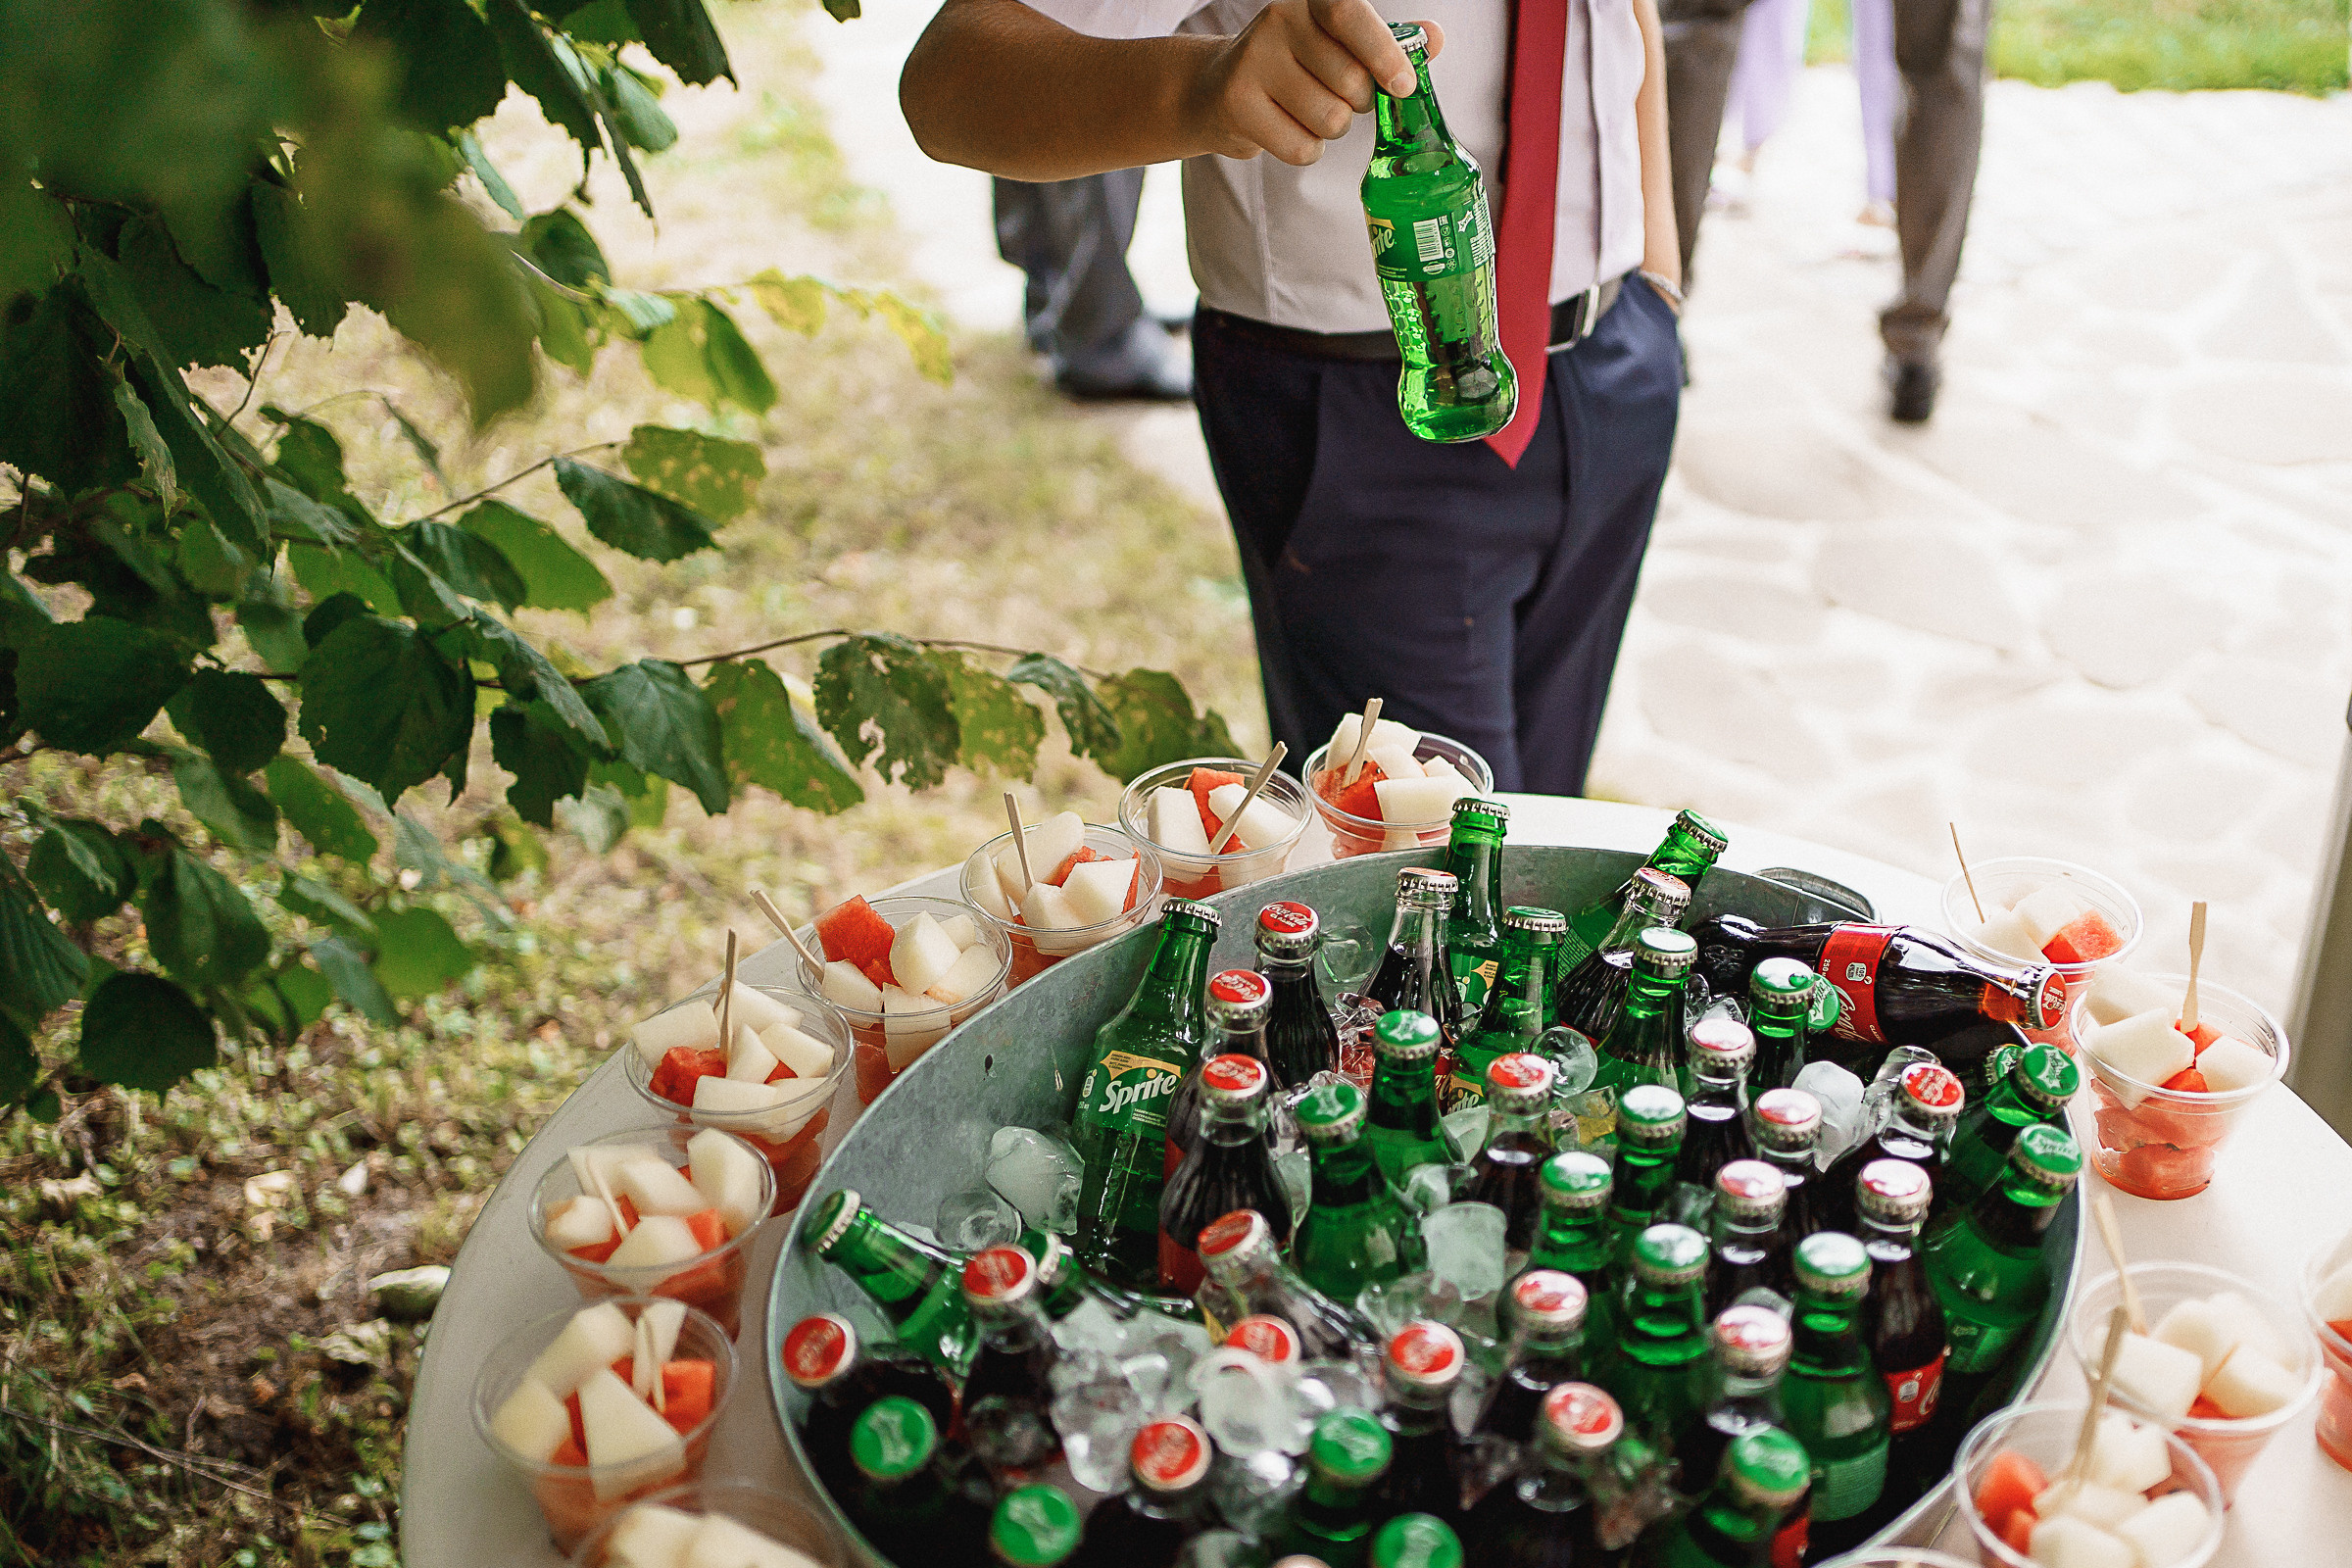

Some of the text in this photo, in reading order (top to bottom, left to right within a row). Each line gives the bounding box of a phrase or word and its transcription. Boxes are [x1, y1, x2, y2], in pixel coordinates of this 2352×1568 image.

[1371, 225, 1396, 259] rite
[1822, 958, 1832, 972] 250
[1099, 1069, 1177, 1114] Sprite
